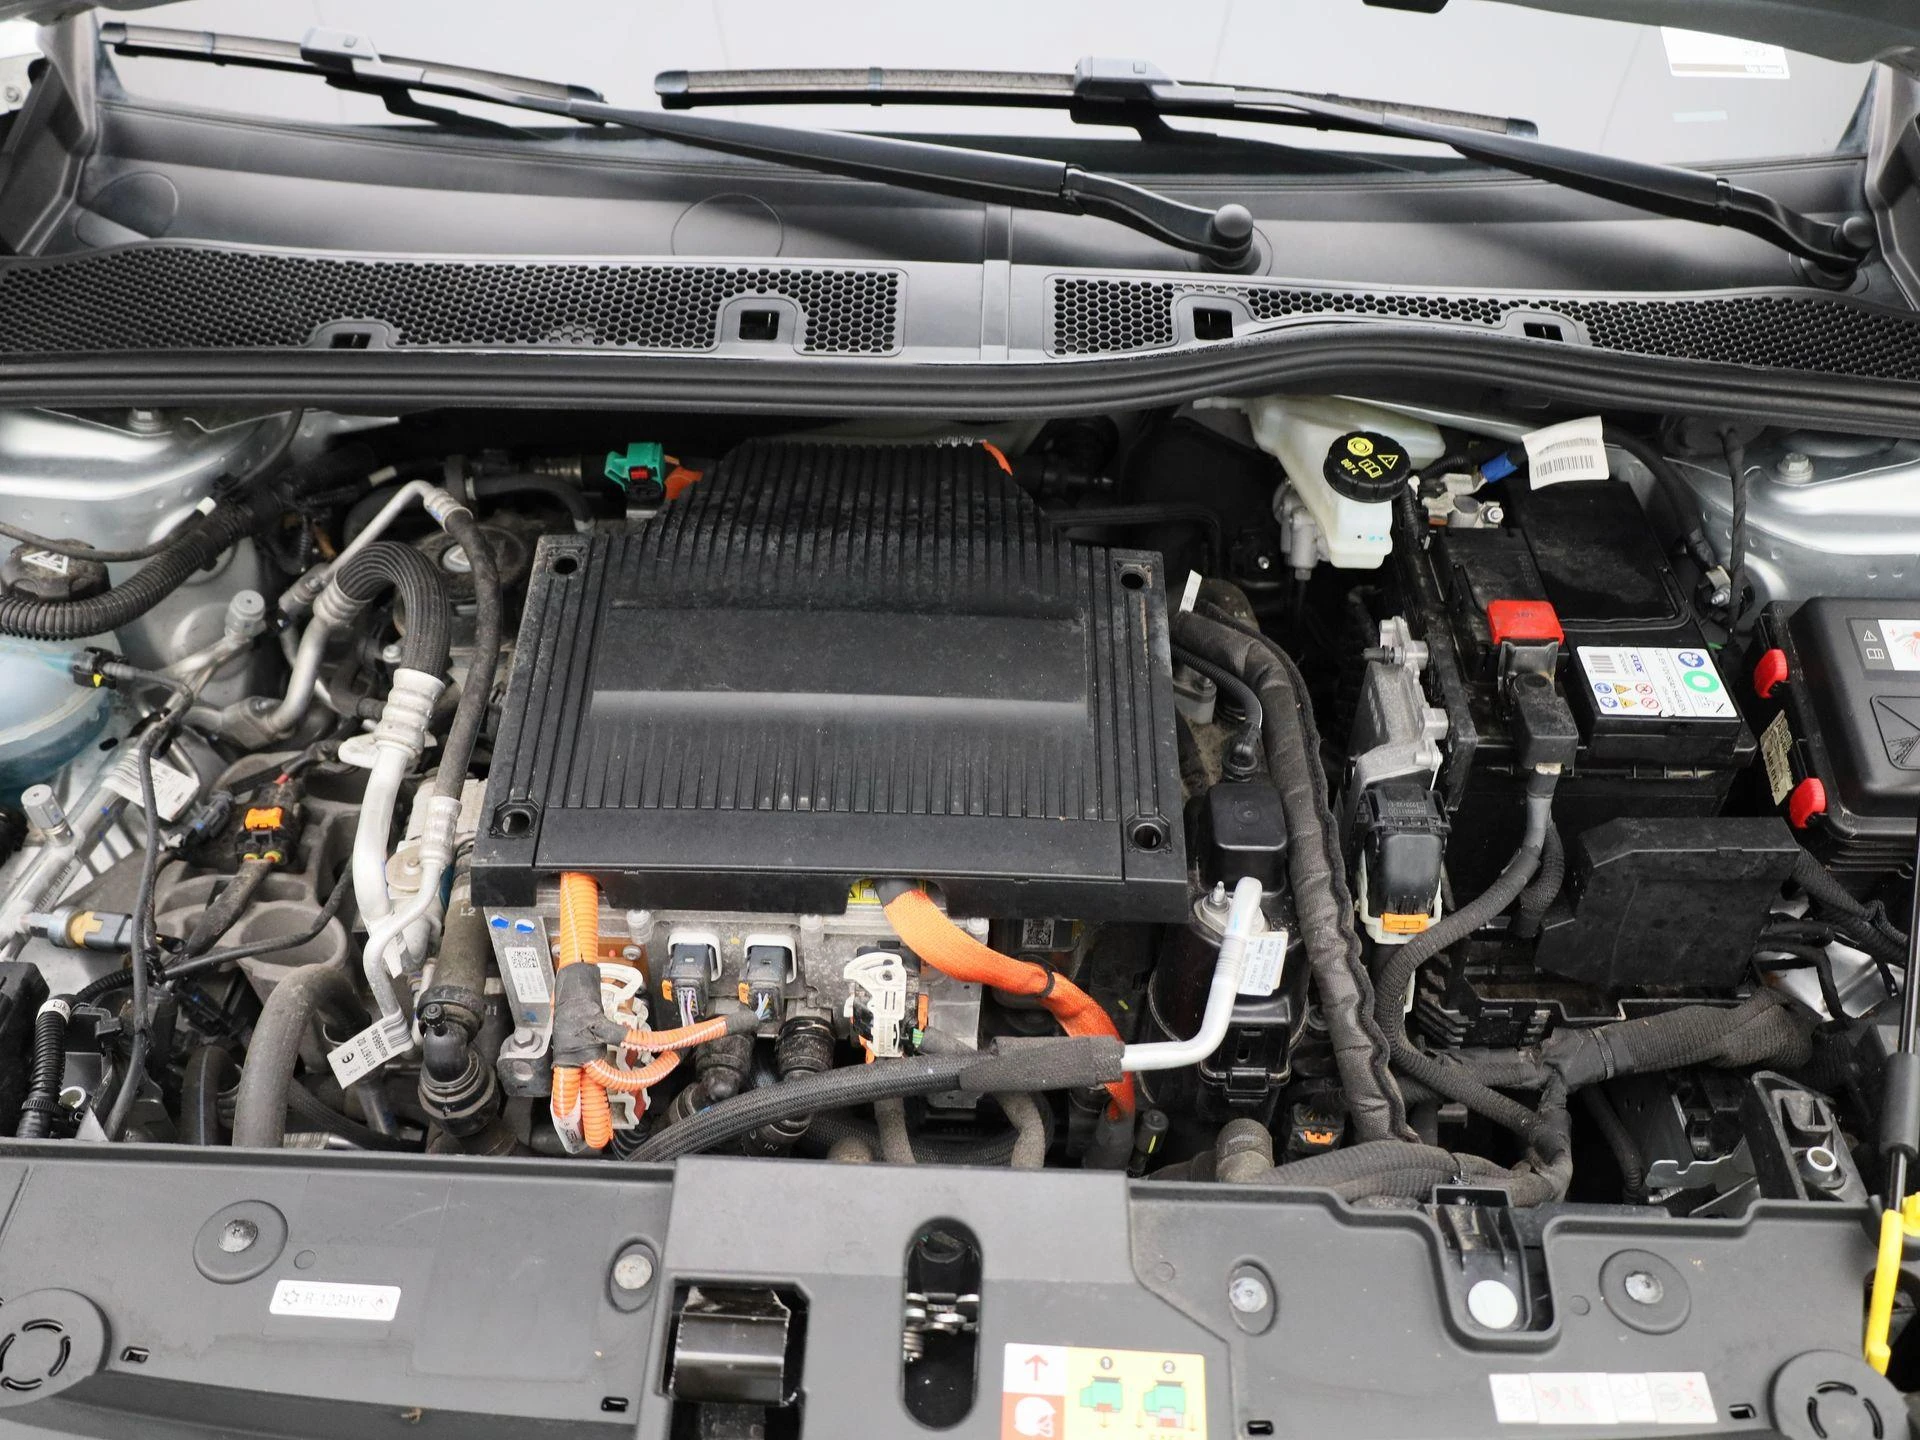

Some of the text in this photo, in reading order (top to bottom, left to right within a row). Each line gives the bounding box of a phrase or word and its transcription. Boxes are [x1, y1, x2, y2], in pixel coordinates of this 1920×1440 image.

[1340, 458, 1356, 471] DOT
[1630, 653, 1644, 673] EXIDE
[460, 907, 476, 916] L2
